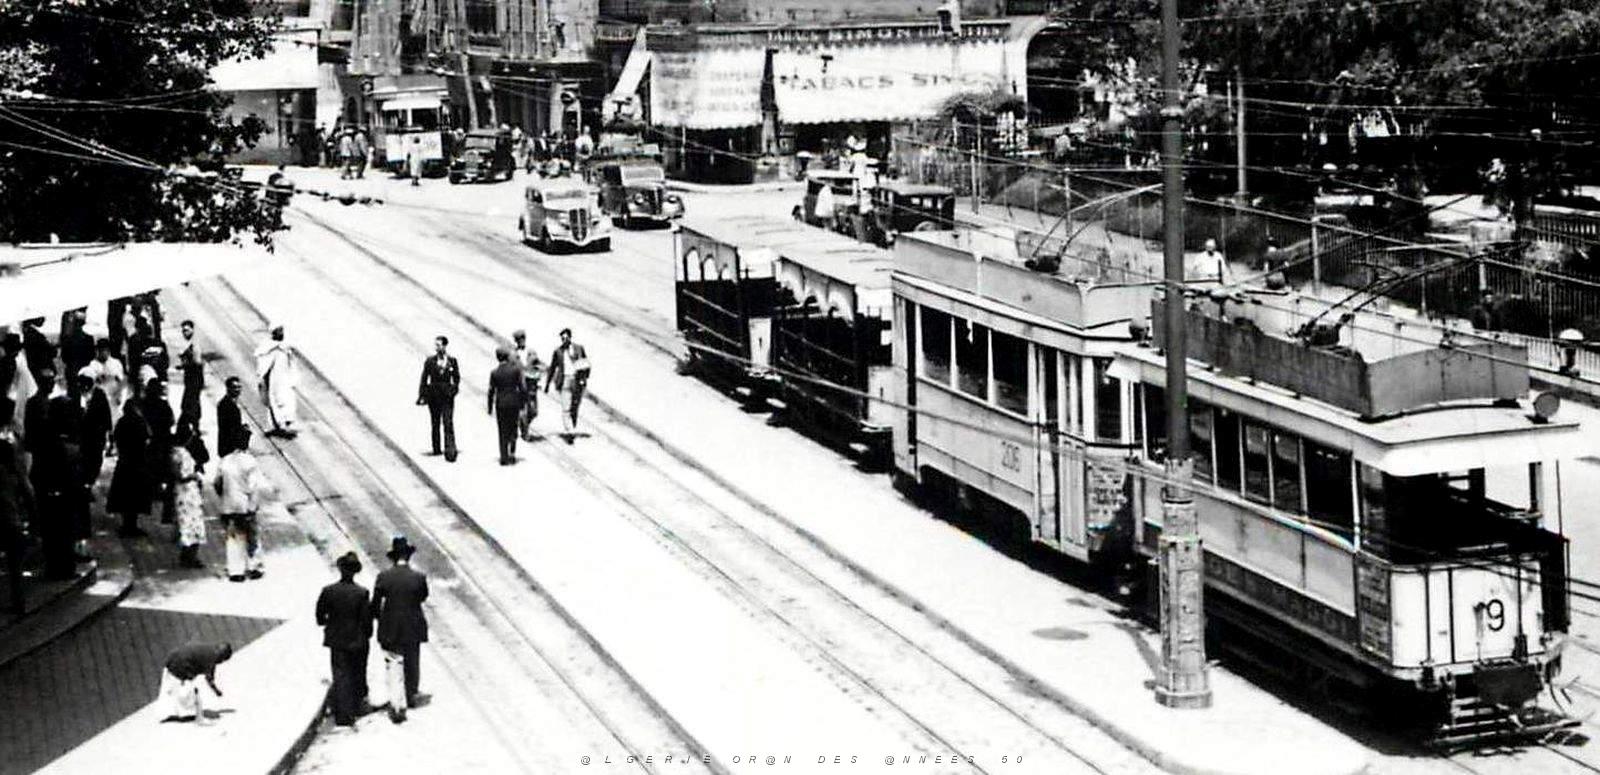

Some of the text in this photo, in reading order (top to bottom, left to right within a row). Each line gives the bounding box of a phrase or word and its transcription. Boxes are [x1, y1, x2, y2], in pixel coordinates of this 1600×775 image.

[828, 28, 911, 41] SIMON
[788, 75, 894, 90] TABACS
[1486, 599, 1505, 632] 9
